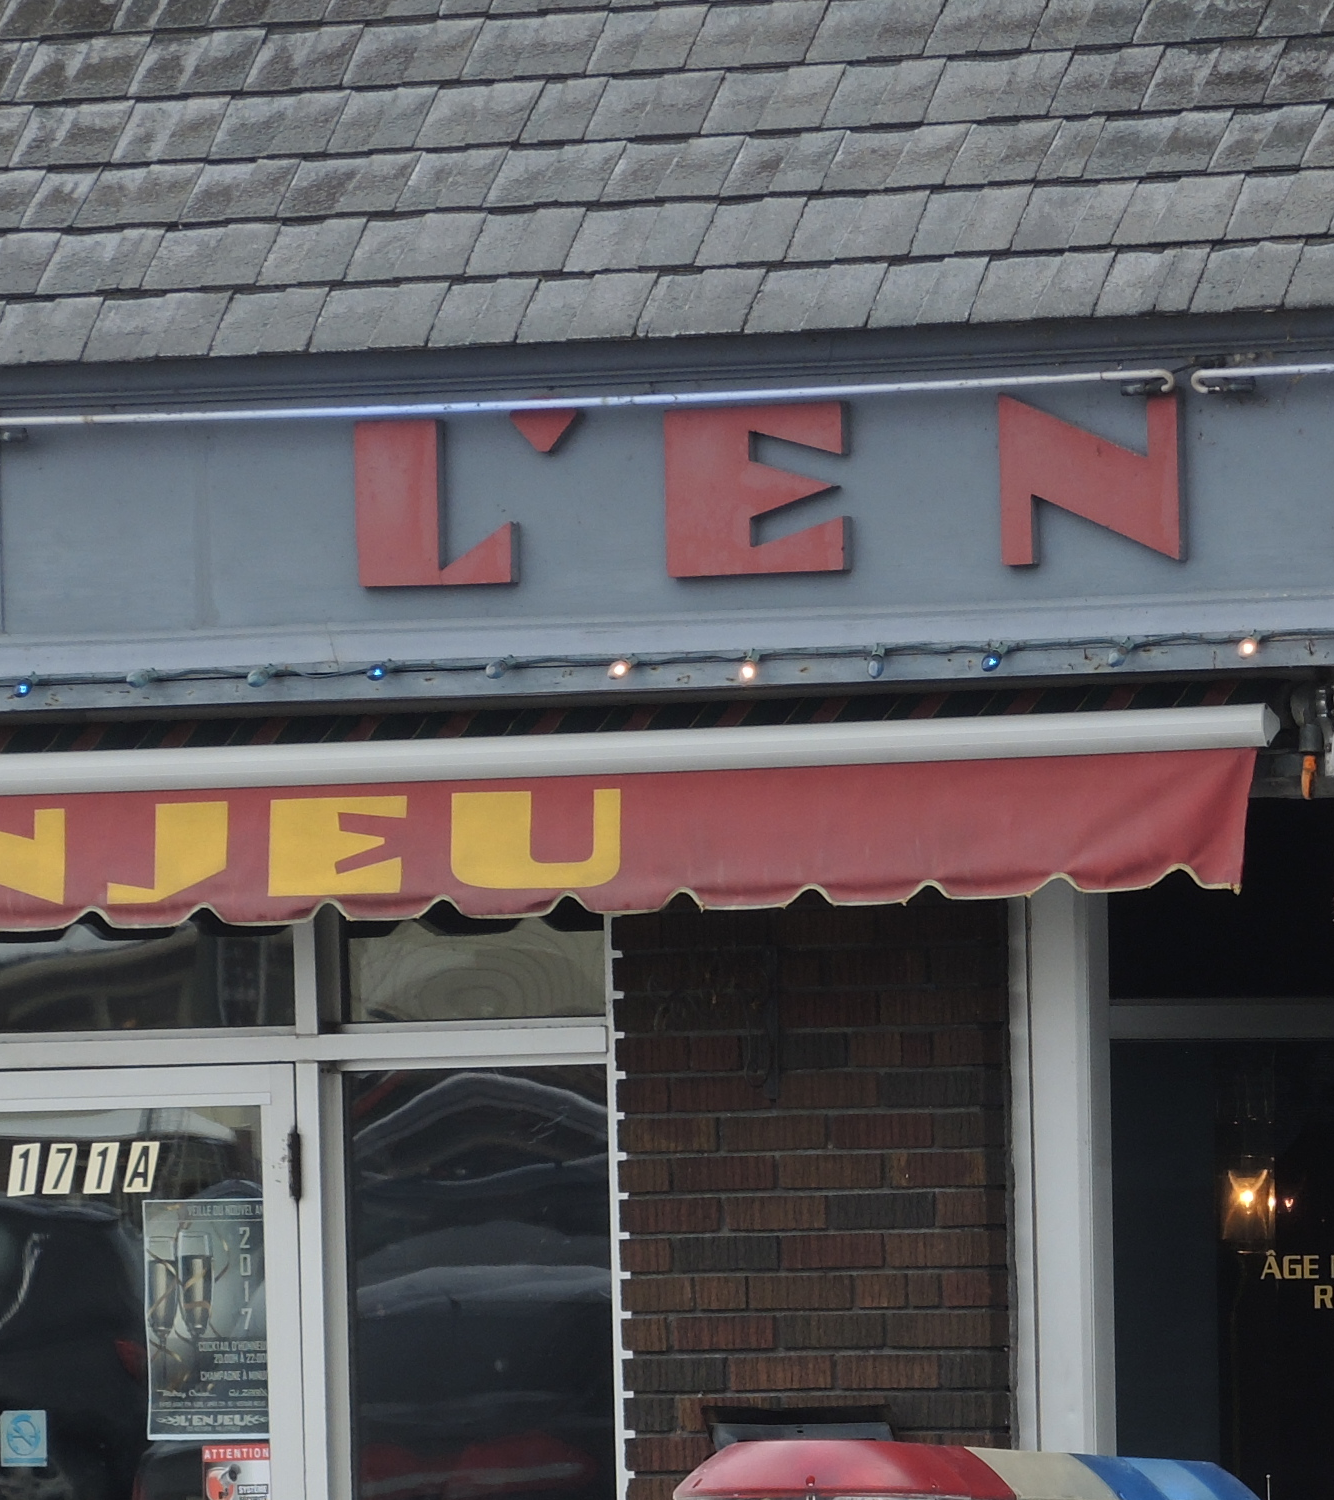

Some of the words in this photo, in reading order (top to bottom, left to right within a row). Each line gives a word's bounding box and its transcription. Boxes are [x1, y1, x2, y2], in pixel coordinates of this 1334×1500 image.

[9, 1141, 160, 1196] 171A
[1260, 1250, 1320, 1280] ÂGE
[204, 1447, 270, 1460] ATTENTION
